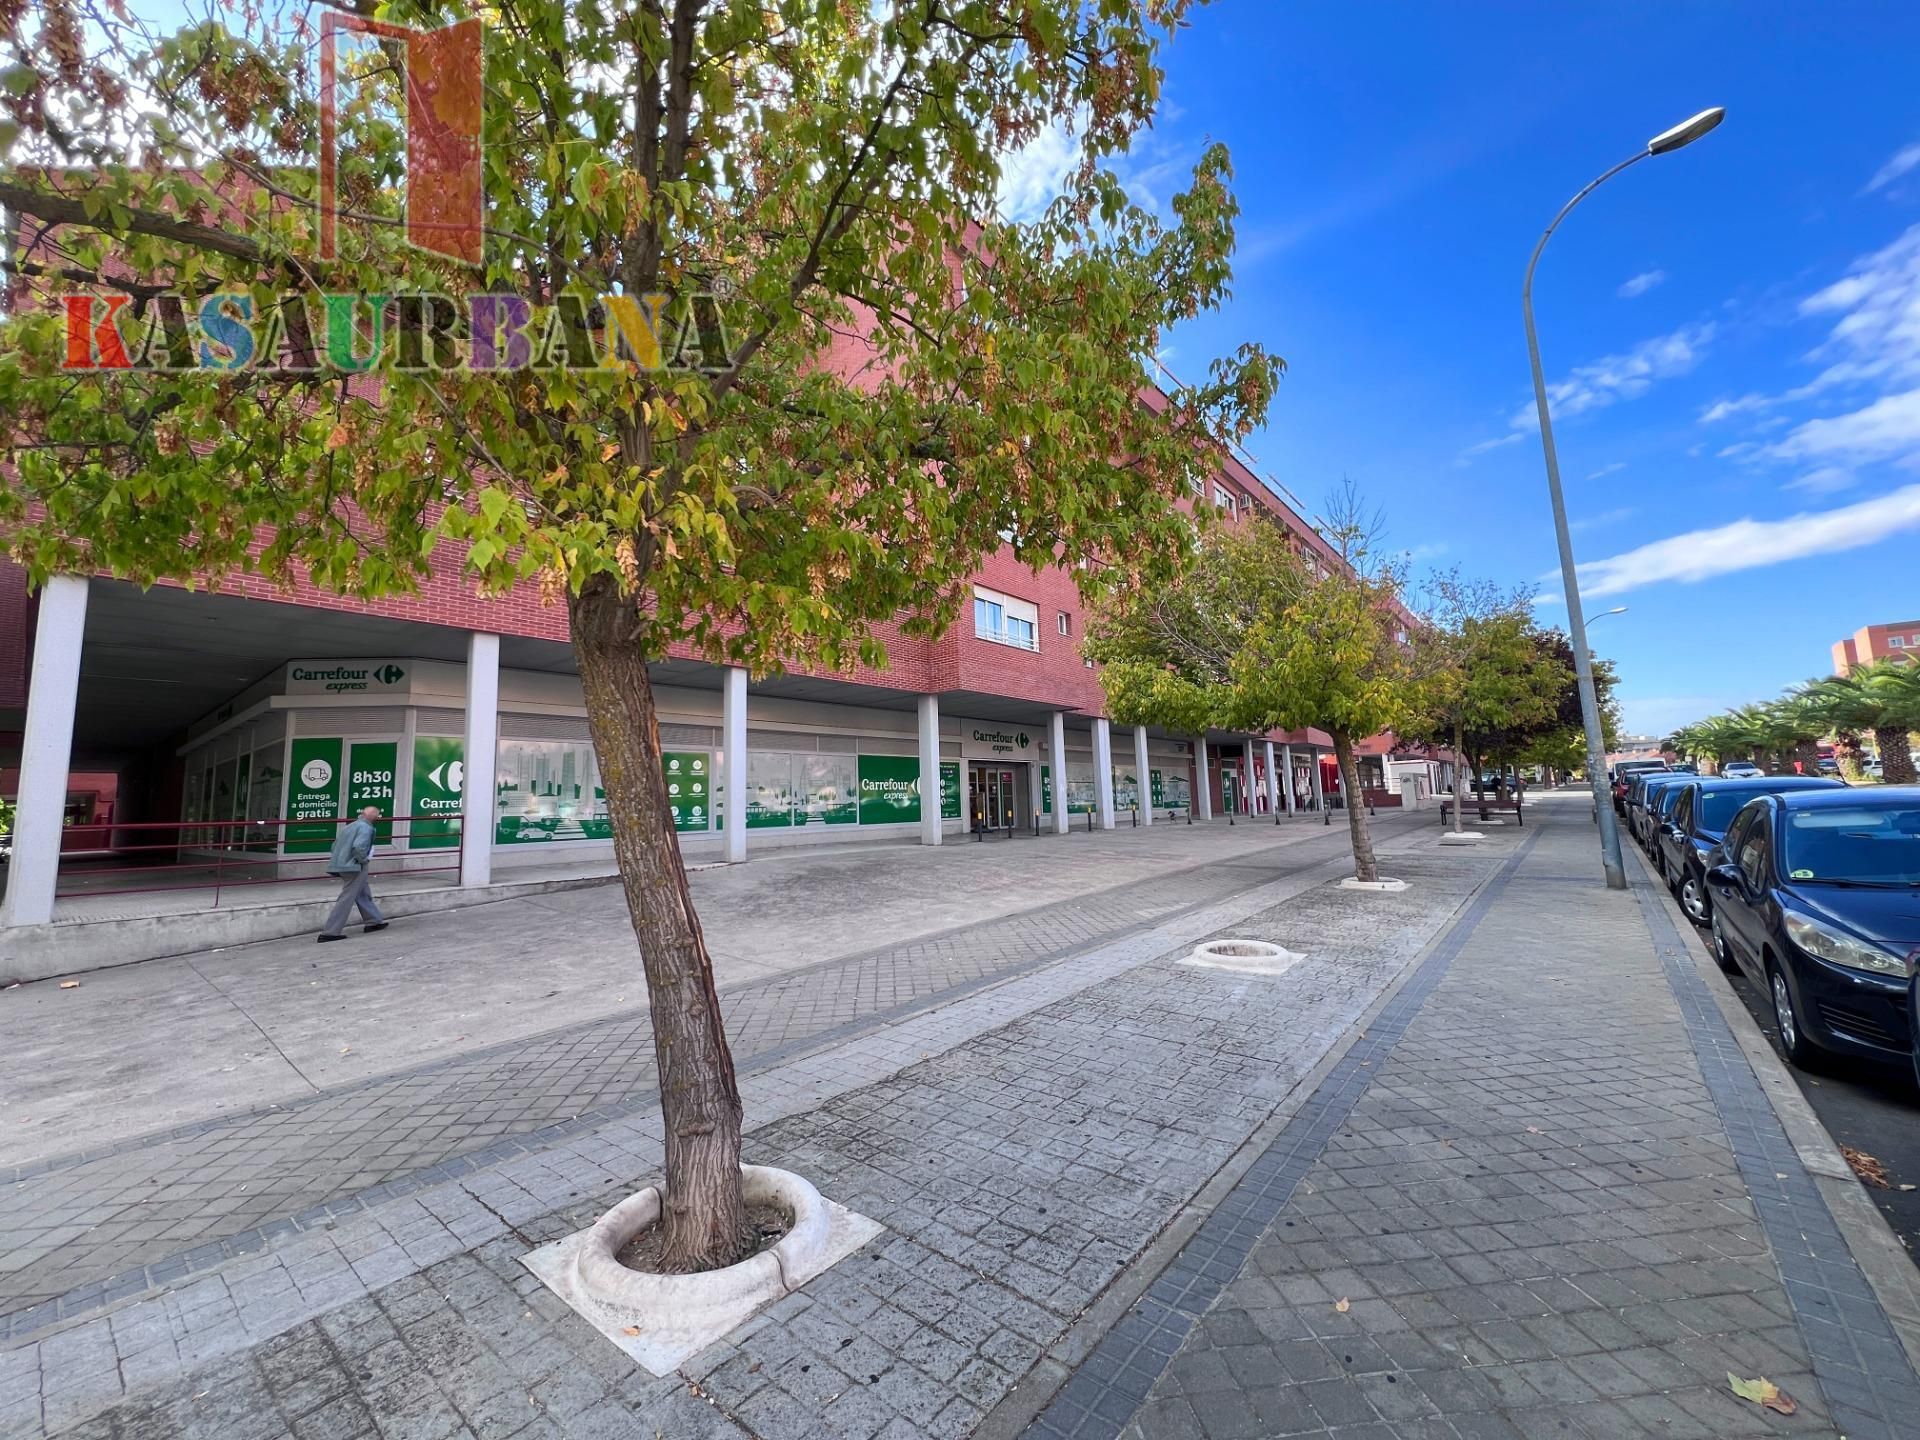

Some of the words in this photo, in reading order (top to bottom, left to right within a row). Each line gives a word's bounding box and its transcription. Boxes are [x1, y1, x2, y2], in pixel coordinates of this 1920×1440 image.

[292, 667, 368, 681] Carrefour
[325, 681, 368, 693] express
[973, 730, 1014, 743] Carrefour
[992, 744, 1014, 755] express
[352, 770, 392, 784] 8h30
[861, 777, 908, 792] Carrefour
[297, 793, 331, 801] Entrega
[883, 791, 909, 803] express
[298, 800, 338, 809] domicilio
[296, 808, 332, 820] gratis
